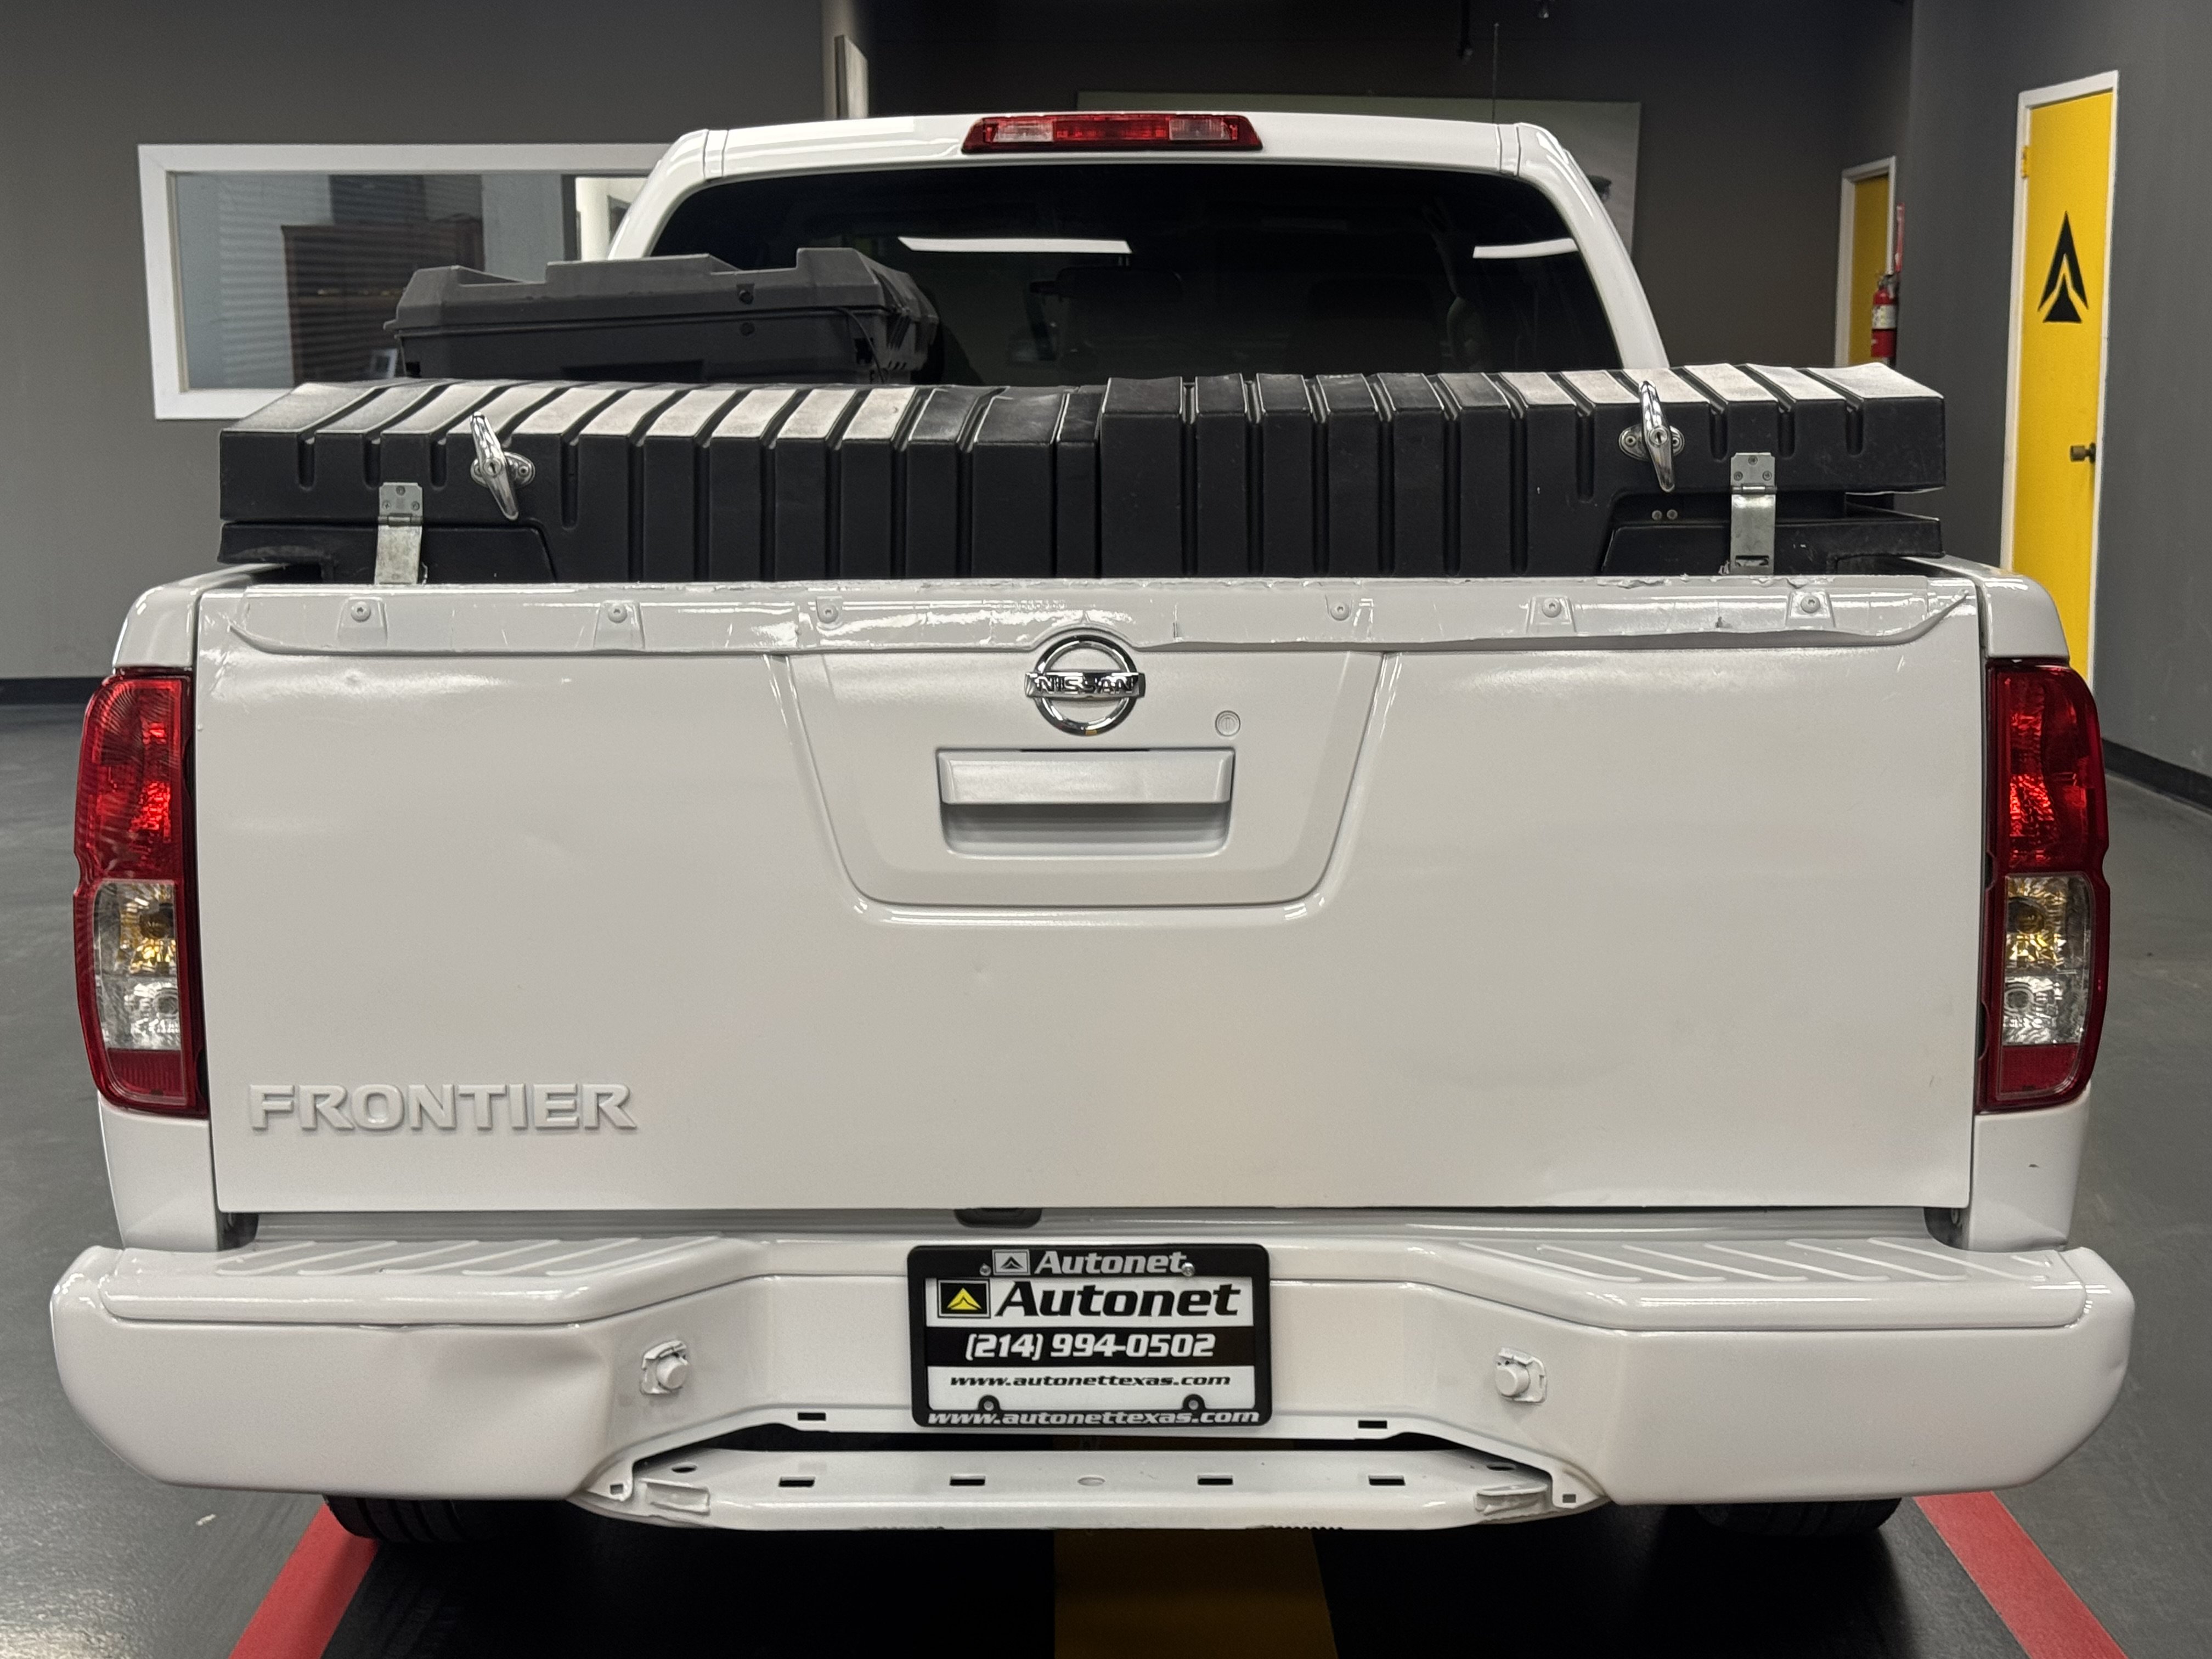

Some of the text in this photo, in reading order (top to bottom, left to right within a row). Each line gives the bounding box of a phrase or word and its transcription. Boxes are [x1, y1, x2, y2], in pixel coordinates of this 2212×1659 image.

[249, 1084, 637, 1132] FRONTIER
[1035, 1251, 1186, 1274] Autonet
[995, 1281, 1240, 1317] Autonet
[966, 1333, 1216, 1361] (214) 994-0502
[950, 1375, 1231, 1386] www.autonettexas.com
[928, 1411, 1260, 1425] www.autonettexas.com
